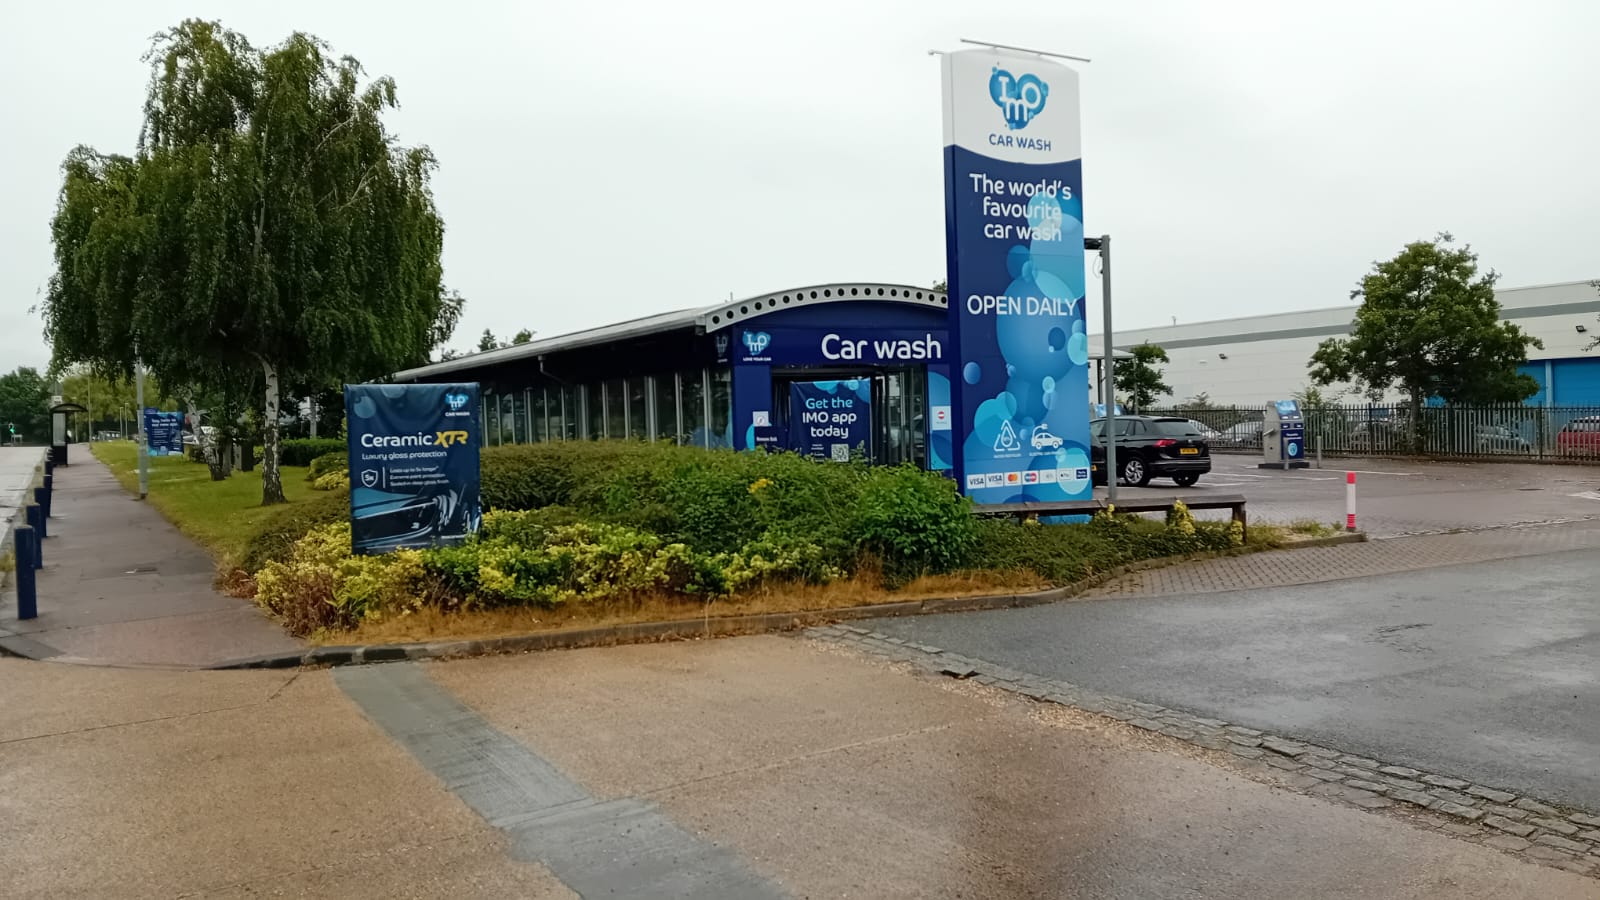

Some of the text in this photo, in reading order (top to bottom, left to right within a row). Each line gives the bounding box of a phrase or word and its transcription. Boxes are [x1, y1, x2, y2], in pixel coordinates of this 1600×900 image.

[989, 134, 1052, 151] CAR WASH
[969, 173, 1072, 200] The world's
[983, 196, 1062, 220] favourite
[984, 222, 1062, 242] car wash
[967, 294, 1077, 317] OPEN DAILY
[821, 333, 942, 360] Car wash
[805, 396, 853, 409] Get the
[802, 412, 857, 424] IMO app
[361, 430, 469, 448] Ceramic XTR
[810, 425, 849, 439] today
[362, 450, 447, 461] Luxury gloss protection
[969, 477, 984, 486] VISA
[988, 475, 1002, 483] VISA
